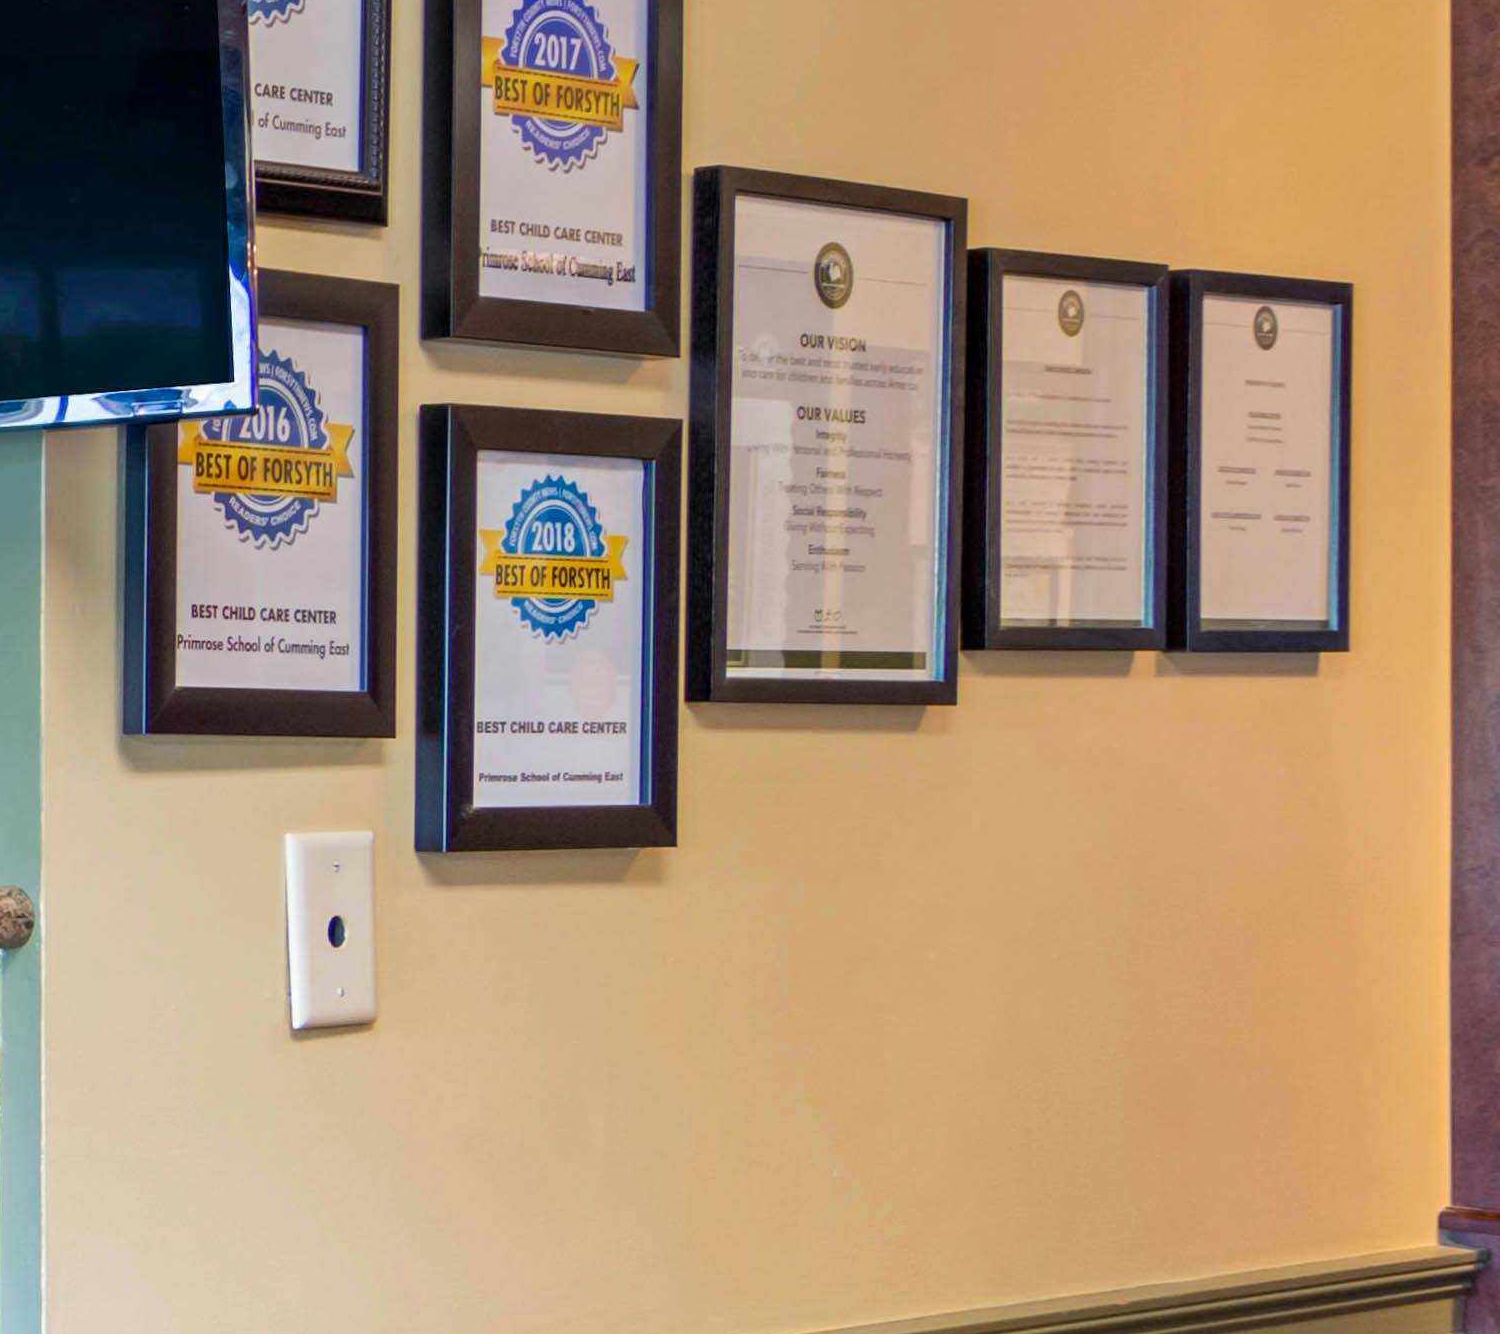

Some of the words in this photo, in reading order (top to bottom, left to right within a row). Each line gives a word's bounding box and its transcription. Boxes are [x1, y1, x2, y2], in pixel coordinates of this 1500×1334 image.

[533, 32, 582, 71] 2017
[255, 83, 285, 99] CARE
[290, 87, 333, 106] CENTER
[494, 76, 528, 103] BEST
[533, 82, 551, 107] OF
[556, 86, 620, 117] FORSYTH
[258, 112, 269, 128] of
[272, 115, 321, 139] Cumming
[325, 122, 346, 138] East
[490, 219, 516, 234] BEST
[519, 222, 550, 238] CHILD
[554, 227, 581, 242] CARE
[584, 230, 623, 246] CENTER
[616, 261, 636, 282] East
[800, 334, 824, 349] OUR
[827, 336, 867, 352] VISION
[238, 405, 291, 442] 2016
[797, 406, 821, 421] OUR
[824, 408, 866, 424] VALUES
[195, 451, 232, 480] BEST
[237, 455, 257, 481] OF
[263, 457, 333, 488] FORSYTH
[270, 499, 300, 526] CHOICE
[532, 521, 575, 553] 2018
[495, 564, 525, 585] BEST
[530, 566, 548, 586] OF
[552, 567, 611, 589] FORSYTH
[191, 604, 218, 619] BEST
[222, 606, 256, 621] CHILD
[260, 608, 290, 623] CARE
[294, 609, 336, 624] CENTER
[176, 634, 223, 651] Primrose
[227, 635, 260, 652] School
[264, 636, 275, 652] of
[278, 638, 326, 660] Cumming
[329, 640, 350, 656] East
[477, 721, 506, 733] BEST
[510, 721, 545, 733] CHILD
[548, 722, 579, 734] CARE
[582, 721, 627, 734] CENTER
[478, 772, 517, 782] Primrose
[520, 772, 550, 782] School
[552, 772, 561, 782] of
[563, 772, 602, 784] Cumming
[604, 772, 624, 781] East
